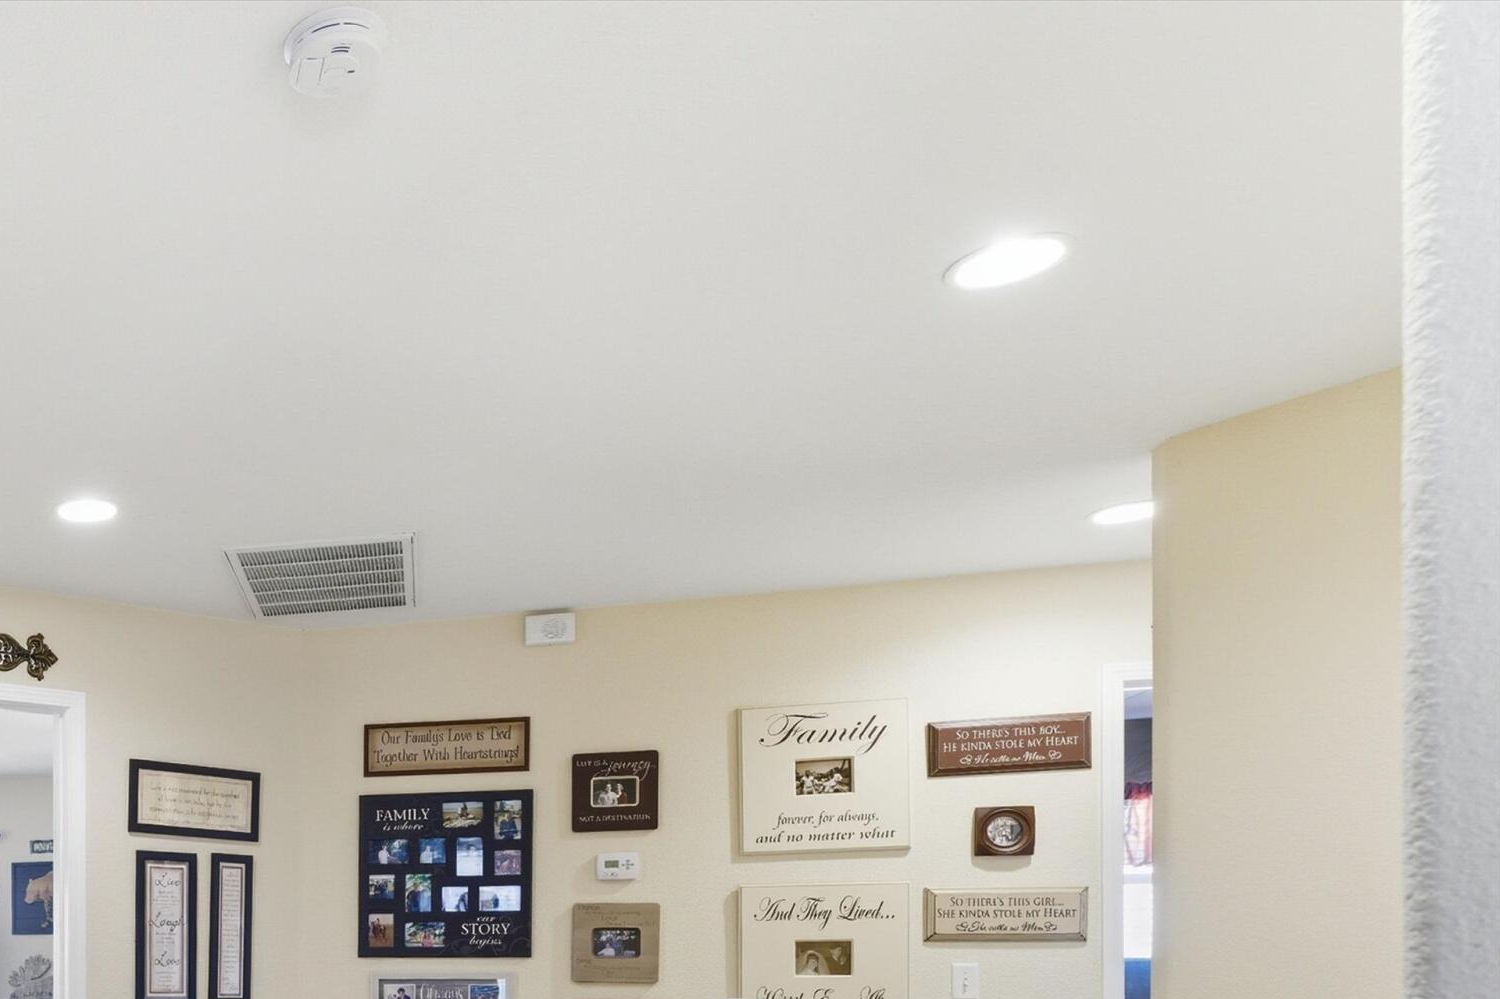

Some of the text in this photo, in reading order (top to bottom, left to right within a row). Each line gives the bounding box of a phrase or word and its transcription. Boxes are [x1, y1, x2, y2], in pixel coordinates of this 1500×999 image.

[381, 725, 512, 746] Our Family's Love is Tied
[758, 712, 887, 755] Family
[955, 730, 970, 740] SO
[972, 728, 1010, 739] THERE'S
[1013, 726, 1036, 736] THIS
[943, 735, 1080, 752] HE KINDA STOLE MY HEART
[373, 748, 419, 768] Together
[422, 747, 450, 761] With
[375, 808, 430, 822] FAMILY
[813, 810, 835, 828] for
[755, 826, 896, 844] and no matter what
[949, 897, 964, 907] SO
[1008, 897, 1030, 907] THIS
[754, 895, 896, 931] And They Lived...
[937, 908, 1077, 919] SHE KINDA STOLE MY HEART
[460, 923, 510, 936] STORY
